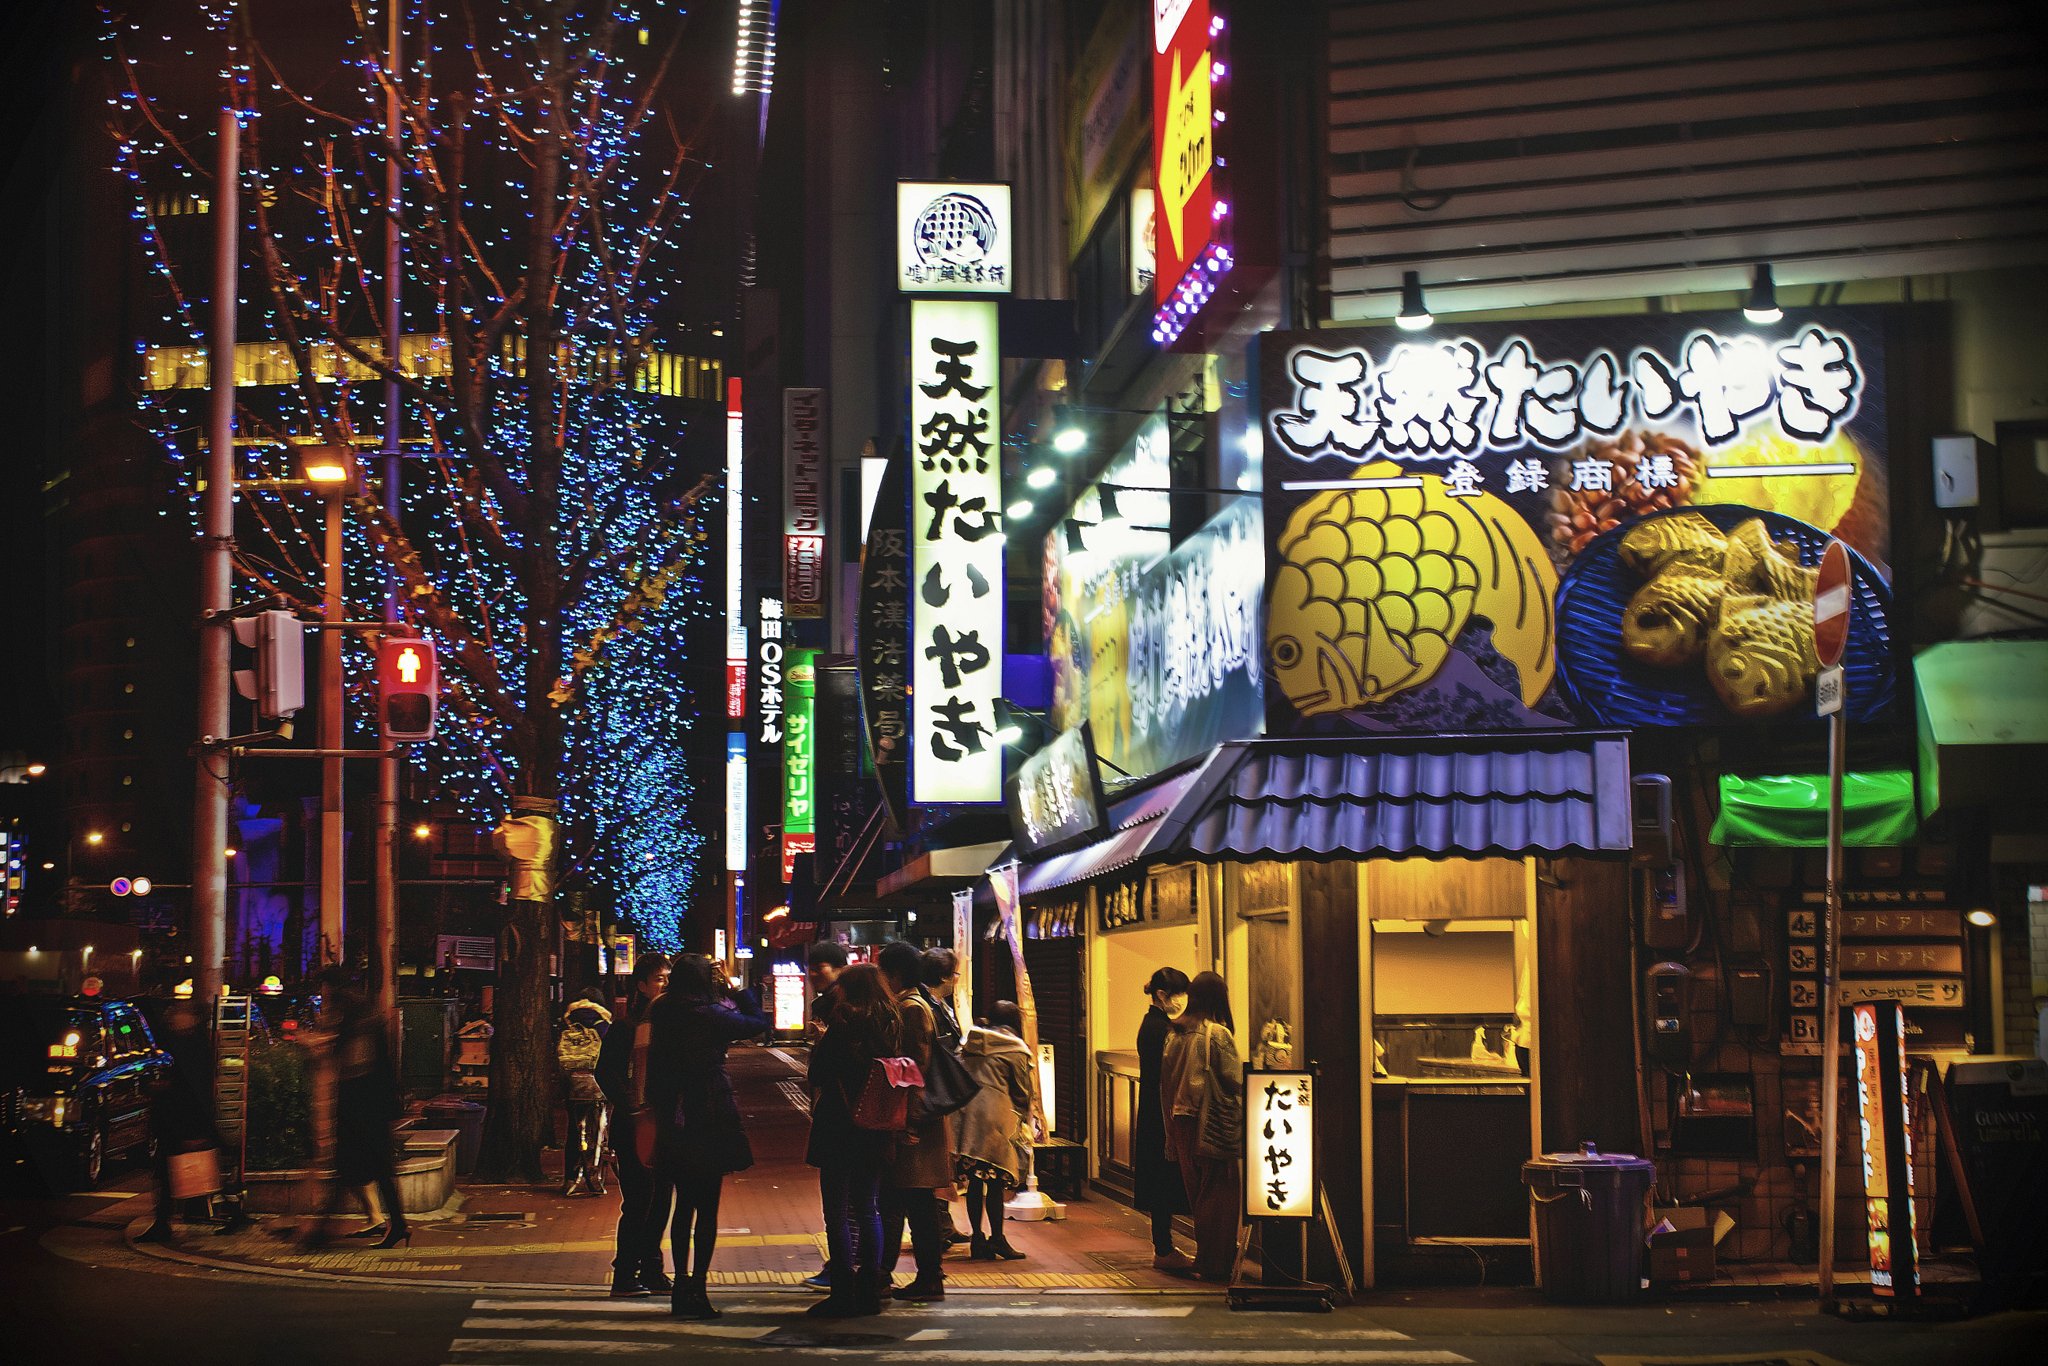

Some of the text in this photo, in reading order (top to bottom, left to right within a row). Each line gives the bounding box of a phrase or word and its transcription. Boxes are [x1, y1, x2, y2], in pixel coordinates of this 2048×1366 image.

[1274, 327, 1860, 456] 天然たいやき
[1443, 454, 1680, 498] 登録商標
[918, 336, 1000, 764] 天然たいやき
[786, 713, 809, 817] サイゼリヤ
[1792, 914, 1815, 932] 4F
[1792, 949, 1815, 968] 3F
[1793, 984, 1815, 1003] 2F
[1794, 1018, 1815, 1038] B1
[1263, 1080, 1293, 1211] たいやき
